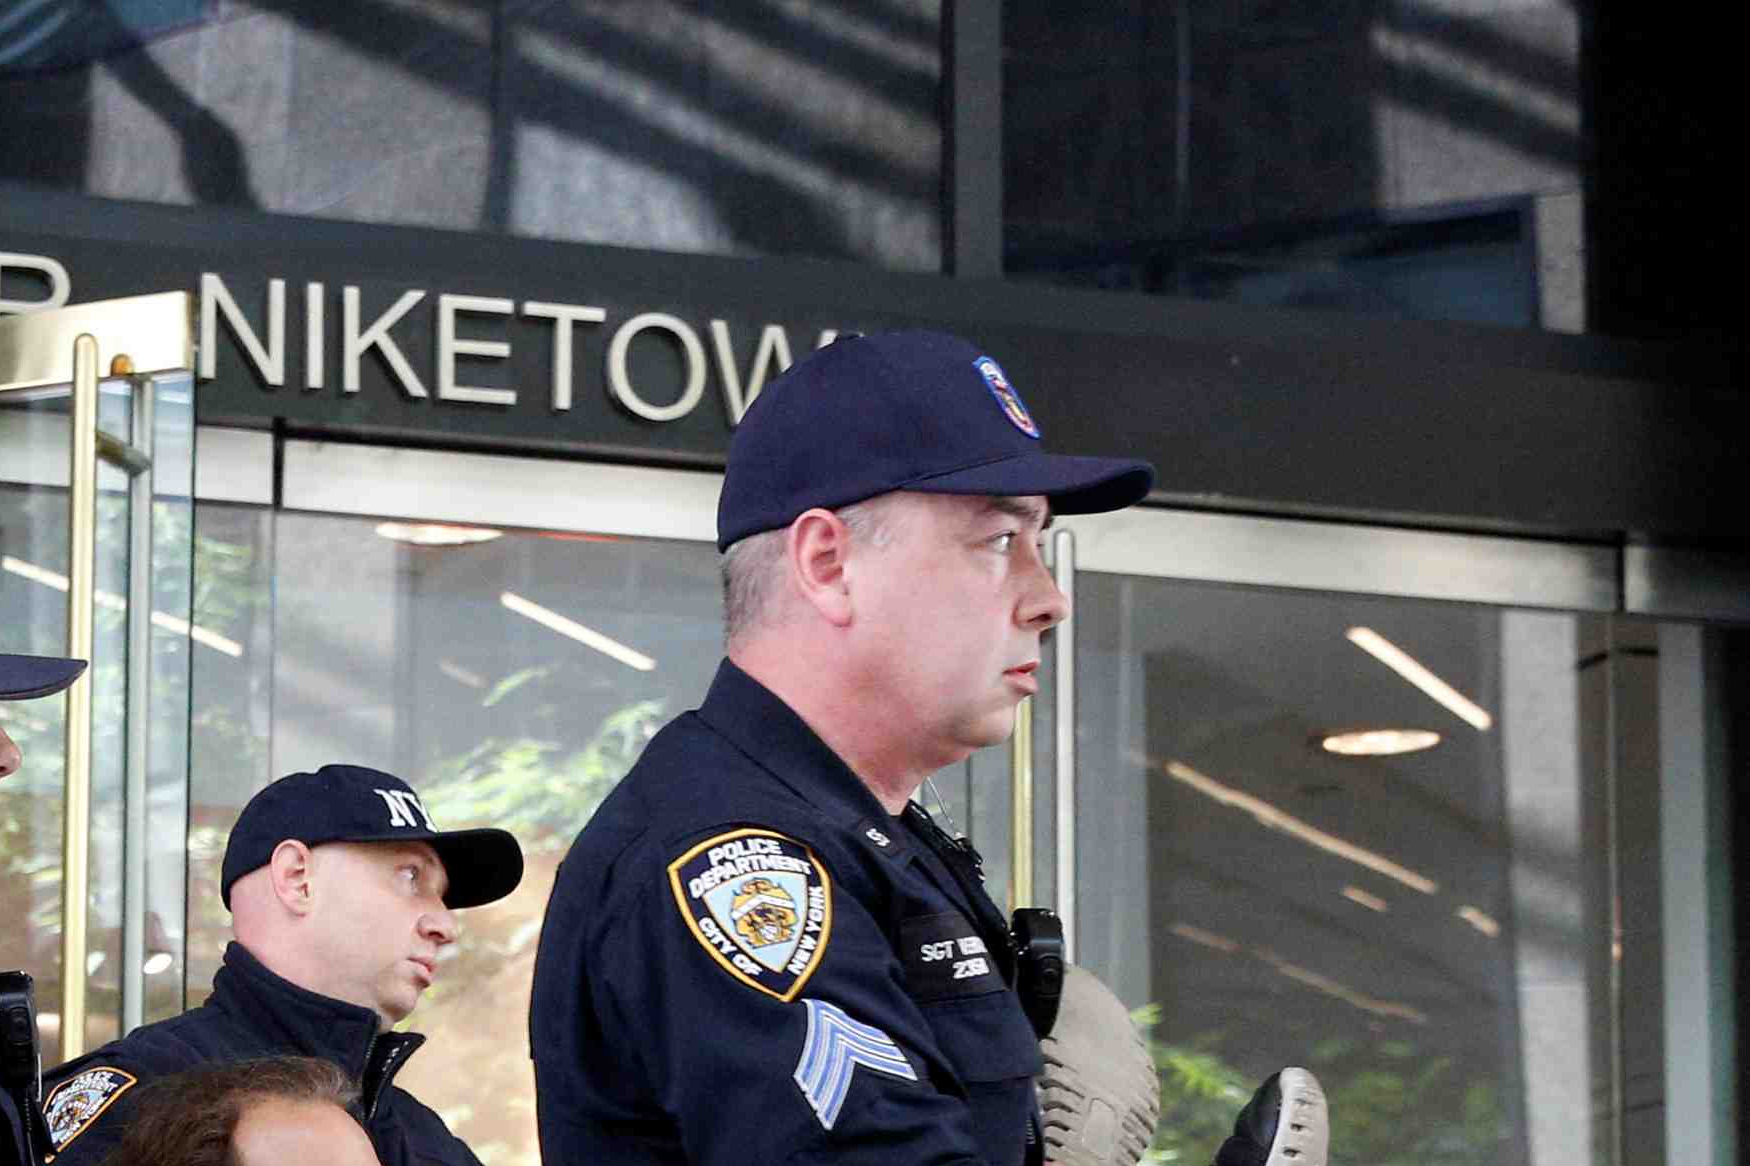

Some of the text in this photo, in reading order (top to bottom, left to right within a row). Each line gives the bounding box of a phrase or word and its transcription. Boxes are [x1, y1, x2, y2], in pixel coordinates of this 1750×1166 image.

[195, 272, 864, 425] NIKETOW
[687, 854, 812, 899] DEPARTMENT
[708, 838, 783, 866] POLICE
[698, 917, 763, 976] CITY OF
[787, 886, 826, 976] NEW YORK
[920, 940, 955, 962] SGT
